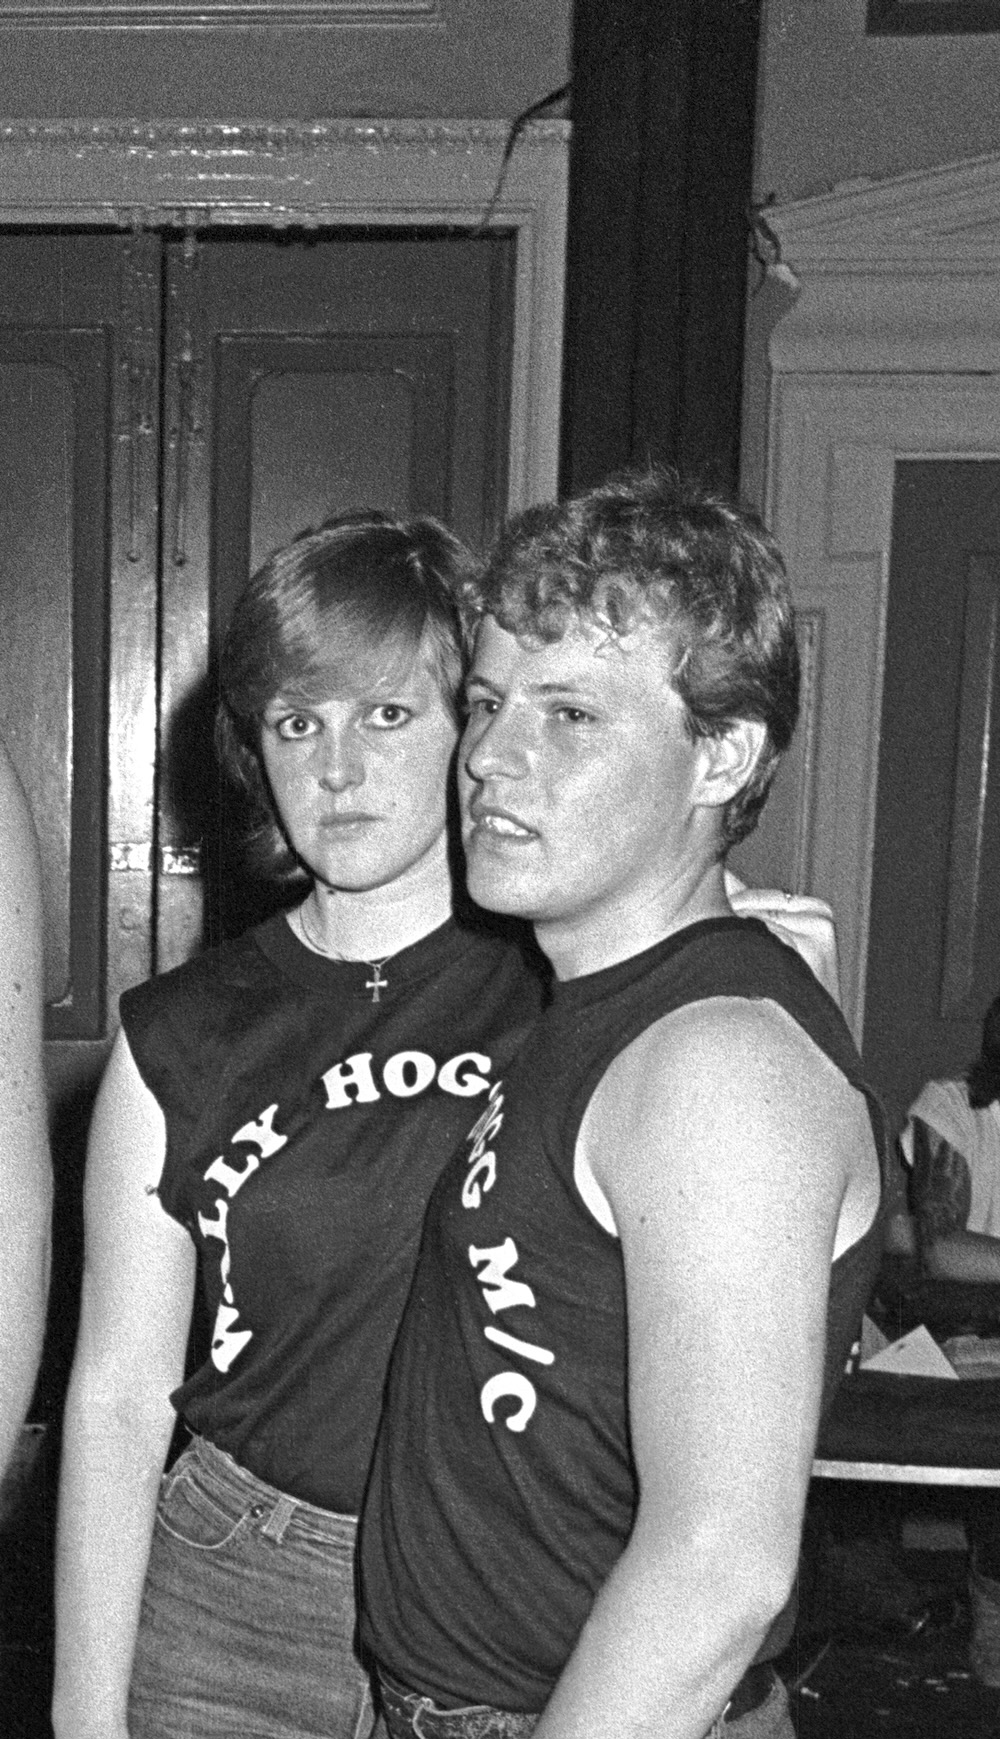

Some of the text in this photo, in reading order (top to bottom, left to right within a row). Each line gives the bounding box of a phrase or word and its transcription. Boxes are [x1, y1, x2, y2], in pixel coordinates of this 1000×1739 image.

[197, 1050, 502, 1374] WLLY HOG
[468, 1236, 556, 1433] M/C
